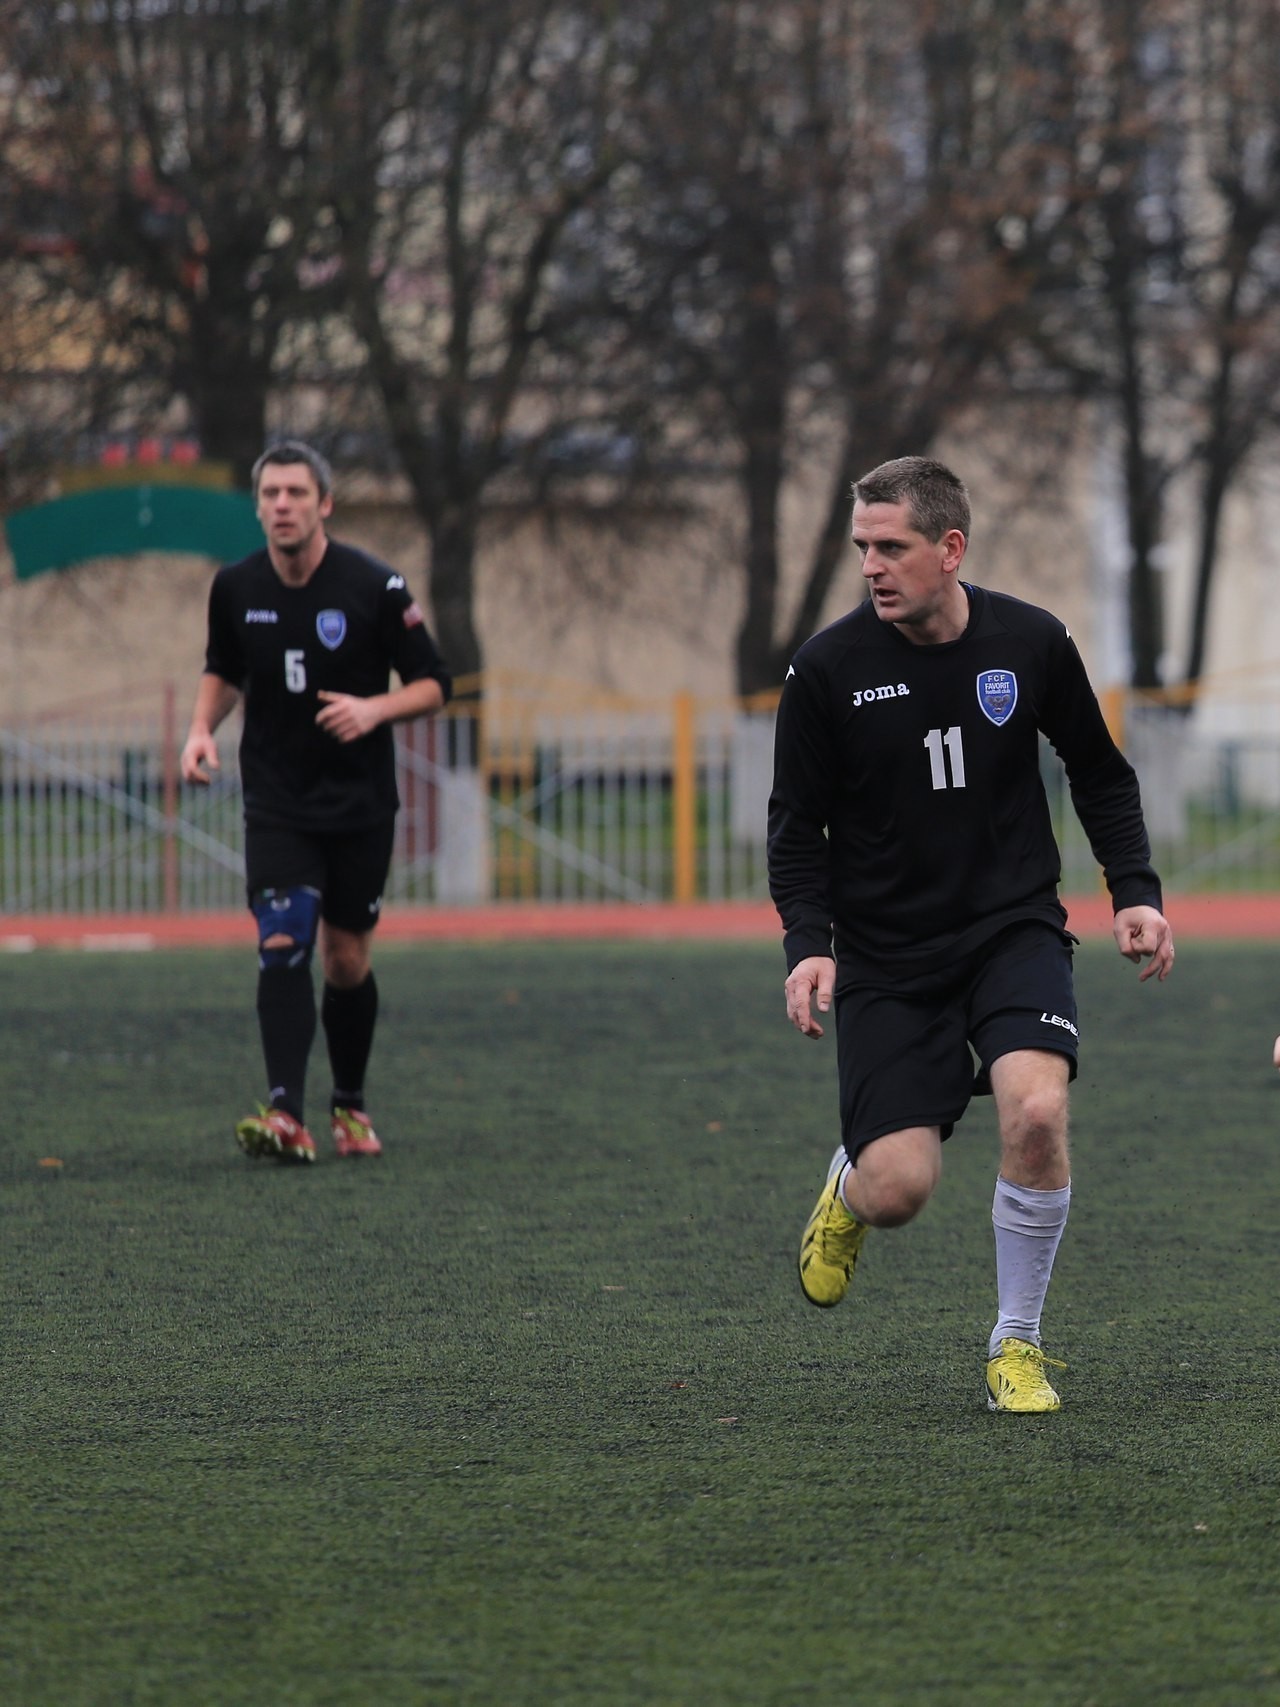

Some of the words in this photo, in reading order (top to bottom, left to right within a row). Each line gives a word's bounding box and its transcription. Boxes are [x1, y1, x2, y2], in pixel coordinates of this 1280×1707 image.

[984, 681, 1010, 690] FAVORIT
[923, 726, 966, 790] 11
[1040, 1012, 1080, 1040] LEGE
